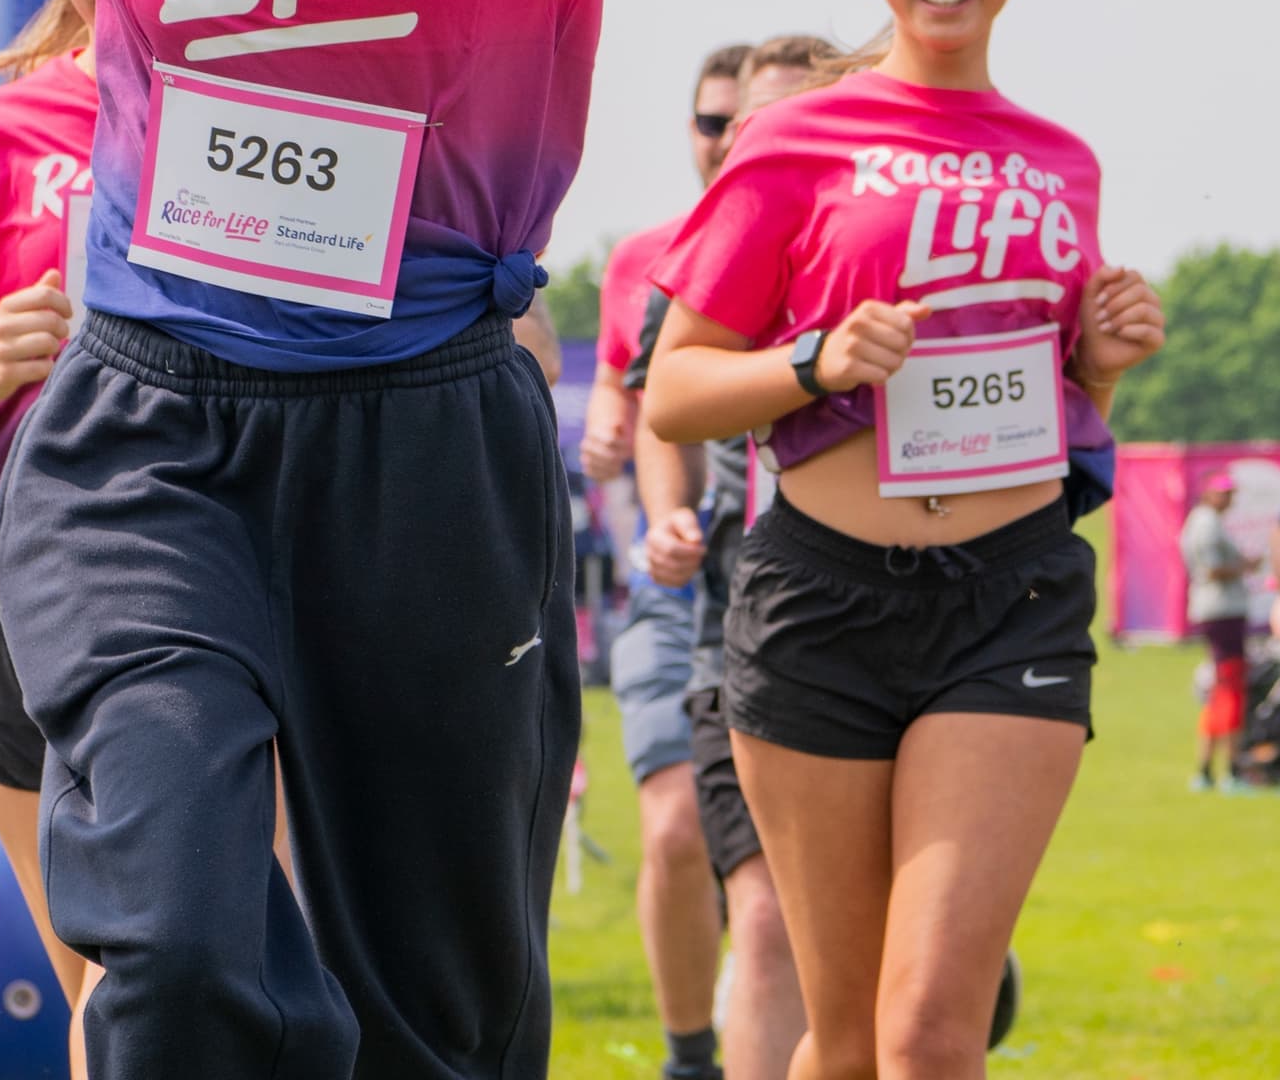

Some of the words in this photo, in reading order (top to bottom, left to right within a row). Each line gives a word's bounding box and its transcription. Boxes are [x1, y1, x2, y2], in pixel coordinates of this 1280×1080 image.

[207, 127, 339, 191] 5263
[852, 146, 993, 197] Race
[1001, 153, 1065, 194] for
[162, 200, 201, 224] Race
[202, 210, 225, 229] for
[225, 212, 269, 236] Life
[276, 225, 337, 247] Standard
[339, 235, 365, 251] Life
[899, 188, 1081, 288] Life
[932, 370, 1025, 409] 5265
[901, 442, 938, 460] Race
[960, 433, 991, 452] Life
